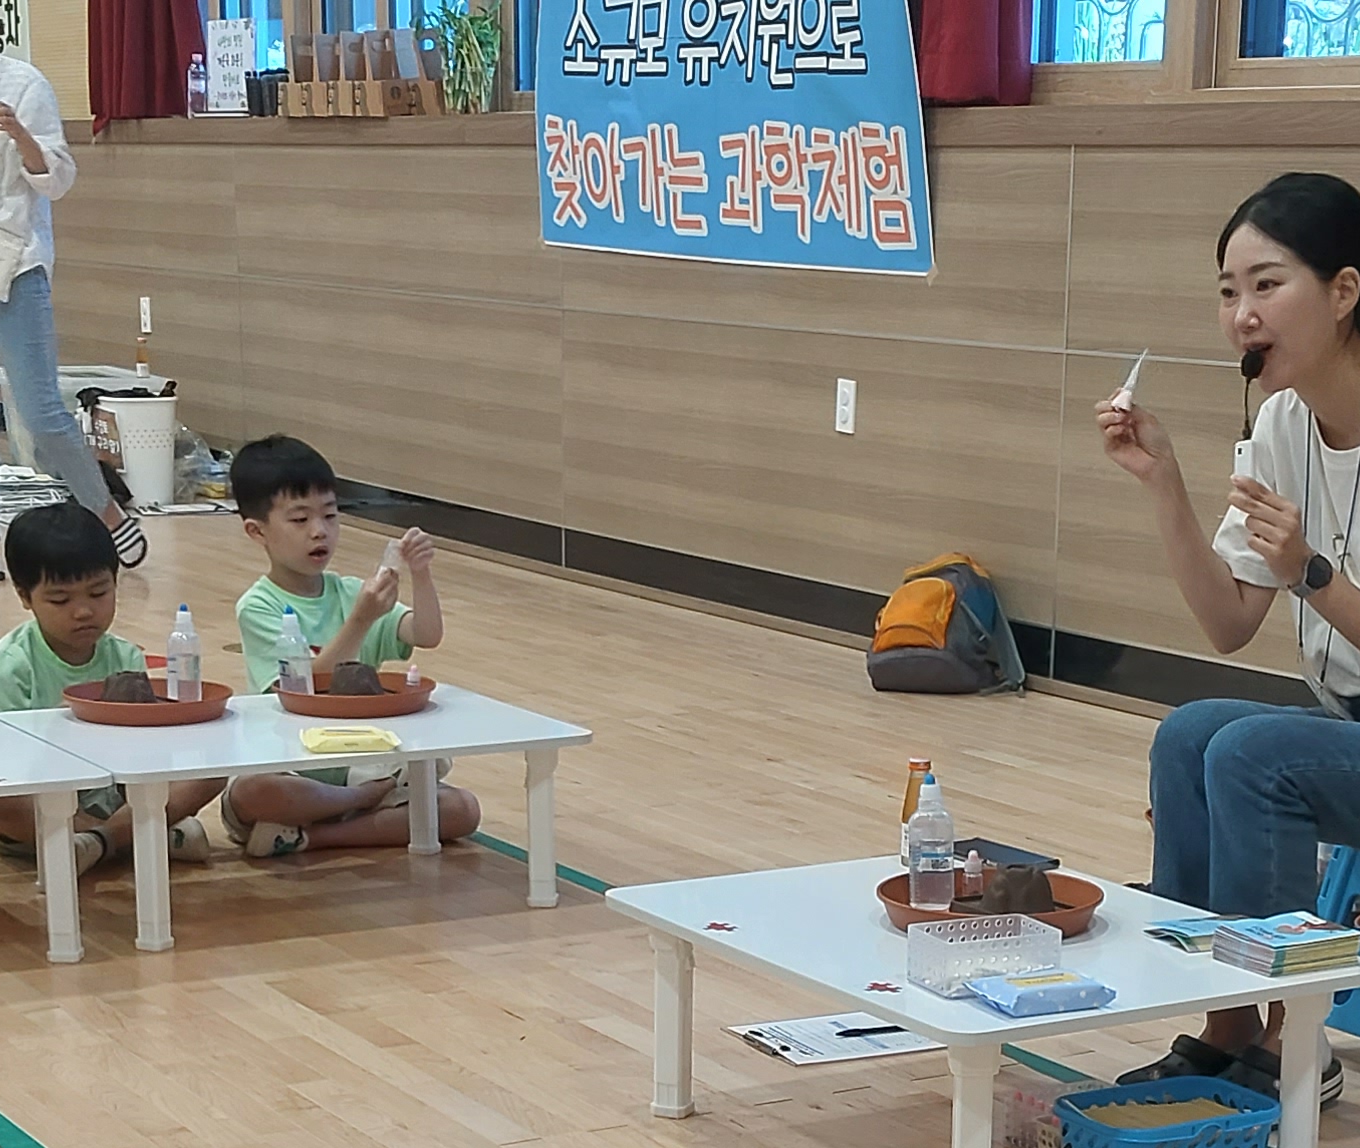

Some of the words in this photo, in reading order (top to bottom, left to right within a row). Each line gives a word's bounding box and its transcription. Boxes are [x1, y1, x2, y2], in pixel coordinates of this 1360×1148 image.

[563, 0, 670, 85] 소규모
[544, 114, 709, 238] 찾아가는
[719, 120, 918, 250] 과학체험
